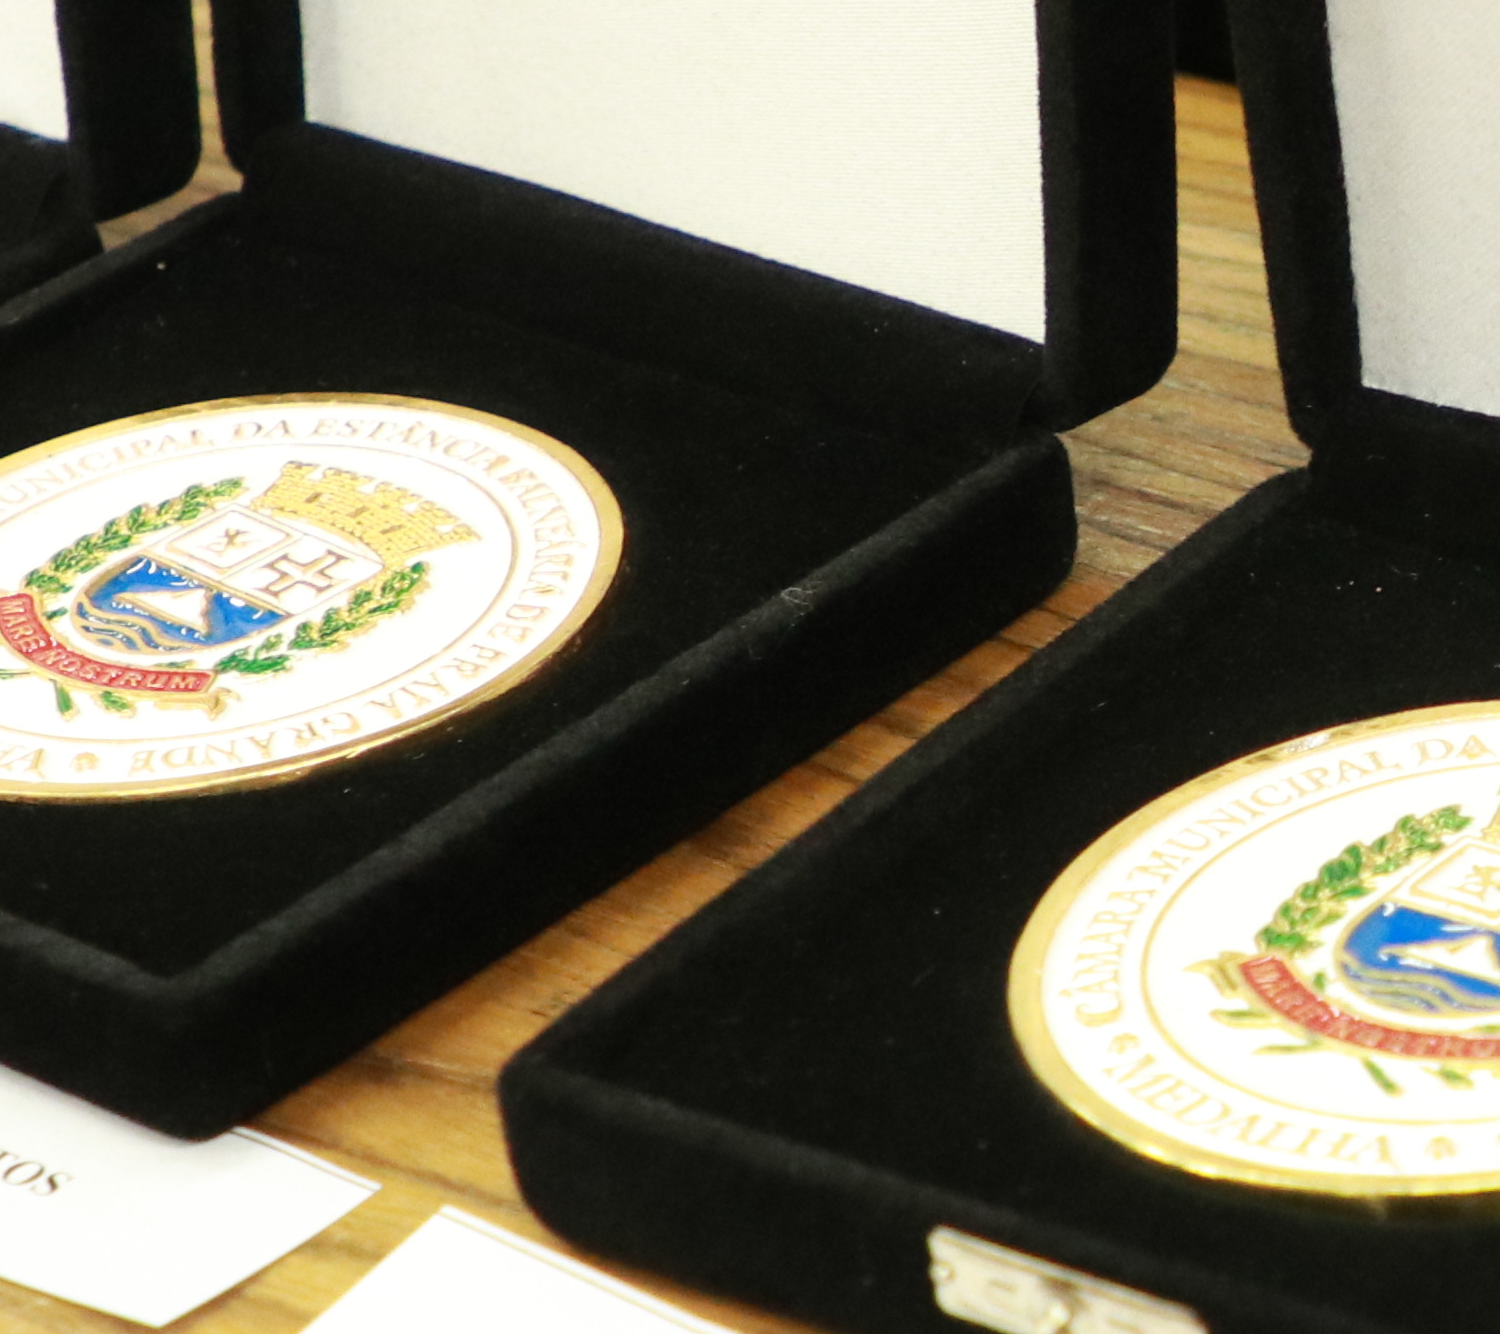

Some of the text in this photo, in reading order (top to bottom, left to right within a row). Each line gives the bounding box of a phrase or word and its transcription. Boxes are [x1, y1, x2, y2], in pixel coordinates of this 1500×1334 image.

[229, 417, 293, 441] DA
[307, 417, 511, 478] ESTÂNCIA
[0, 599, 199, 691] MARE NOSTRUM
[487, 602, 552, 644] DE
[127, 710, 362, 779] GRANDE
[1126, 750, 1401, 885] MUNICIPAL
[1410, 733, 1497, 767] DA
[1101, 1052, 1402, 1174] MEDALHA
